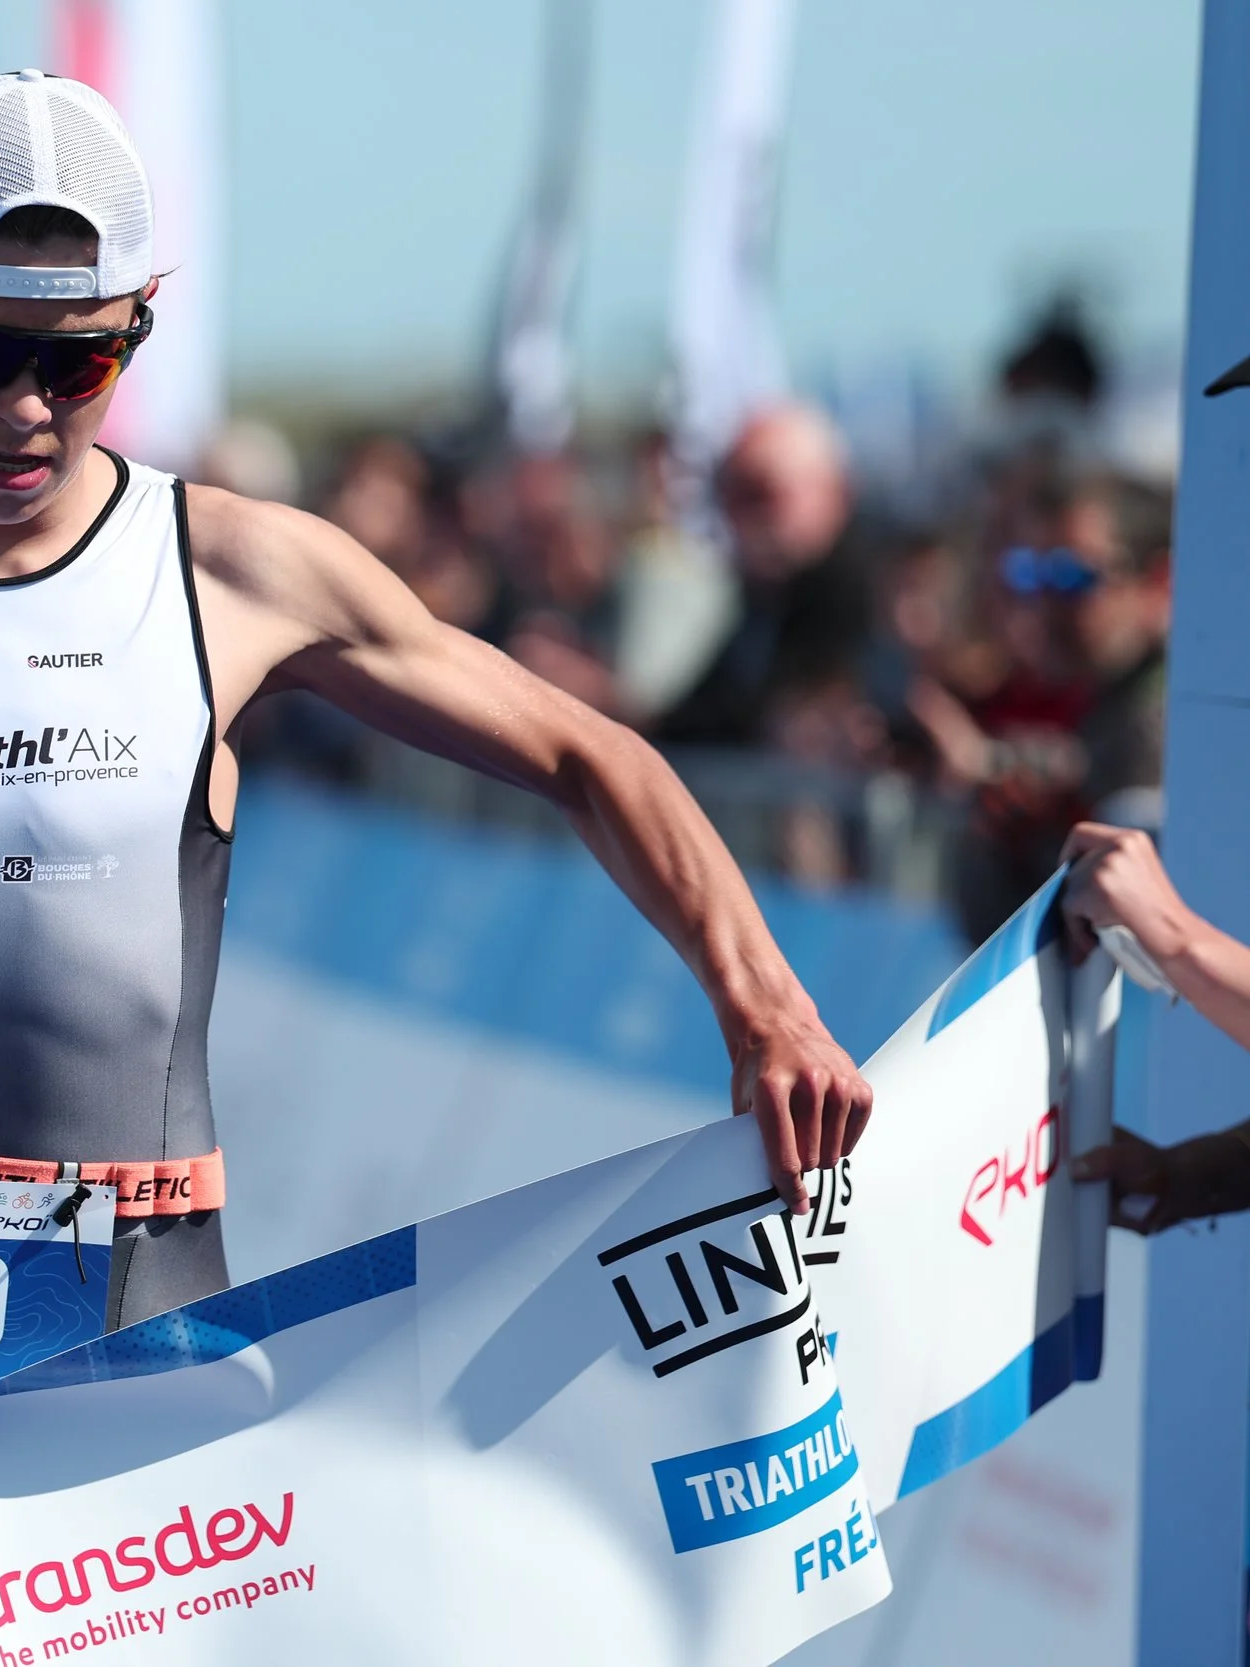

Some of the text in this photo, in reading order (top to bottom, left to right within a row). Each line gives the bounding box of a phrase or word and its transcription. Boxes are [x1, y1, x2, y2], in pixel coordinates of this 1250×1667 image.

[27, 652, 103, 669] GAUTIER
[37, 864, 91, 873] BOUCHES
[43, 1607, 166, 1660] mobility
[176, 1564, 316, 1620] company
